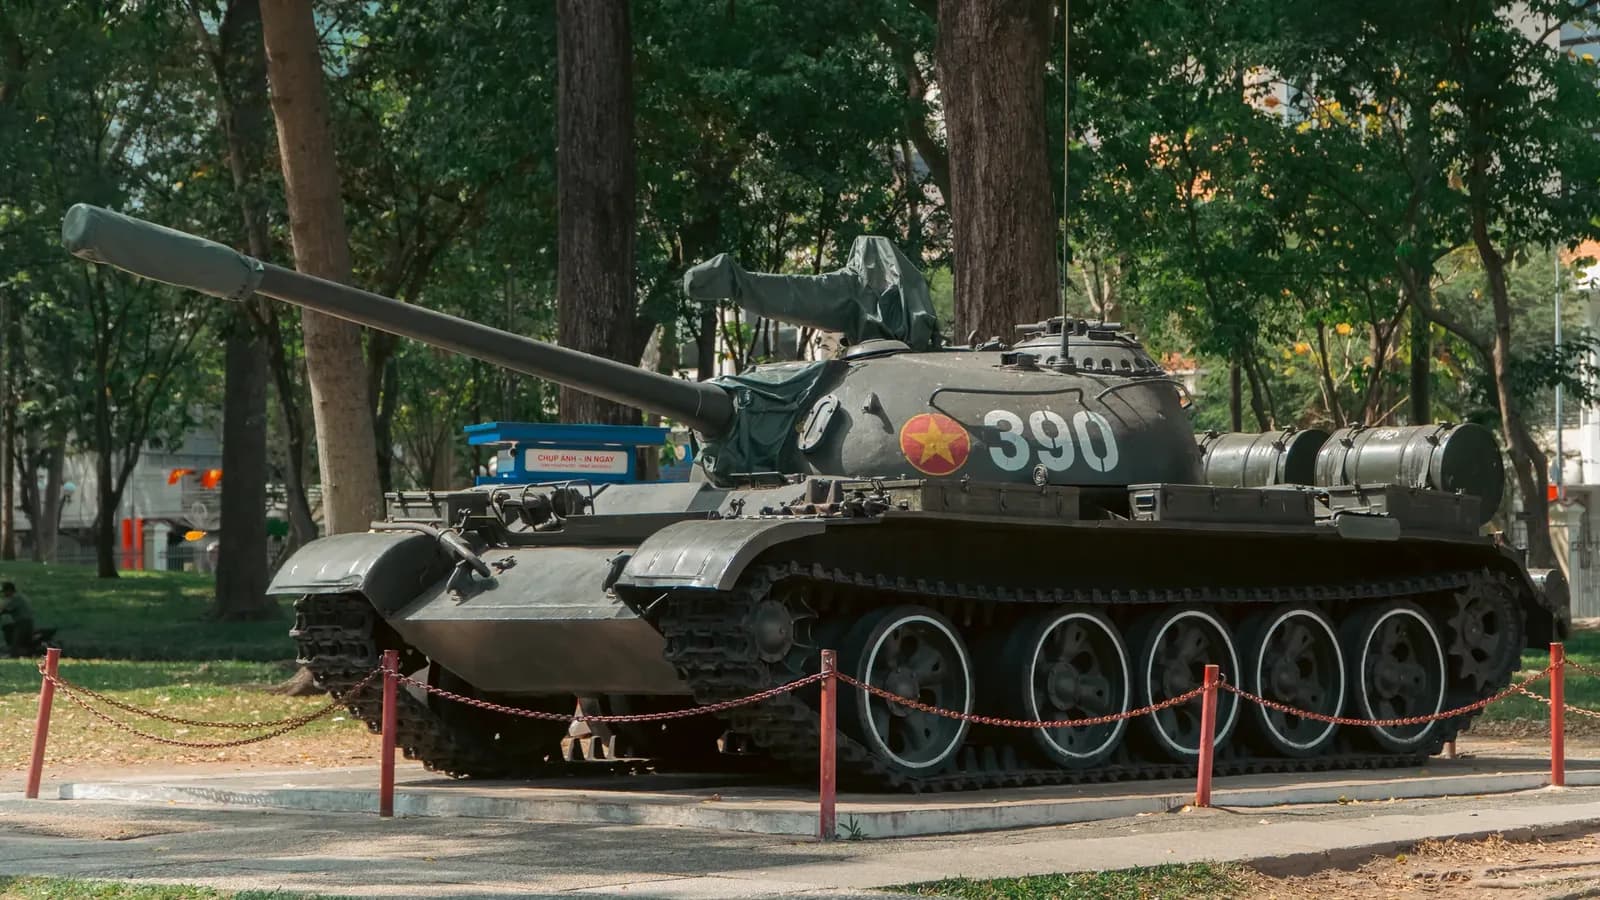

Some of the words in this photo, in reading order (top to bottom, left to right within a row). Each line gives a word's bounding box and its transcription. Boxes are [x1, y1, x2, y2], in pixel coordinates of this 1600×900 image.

[984, 409, 1119, 472] 390
[584, 455, 592, 463] IN
[594, 455, 615, 463] NGAY
